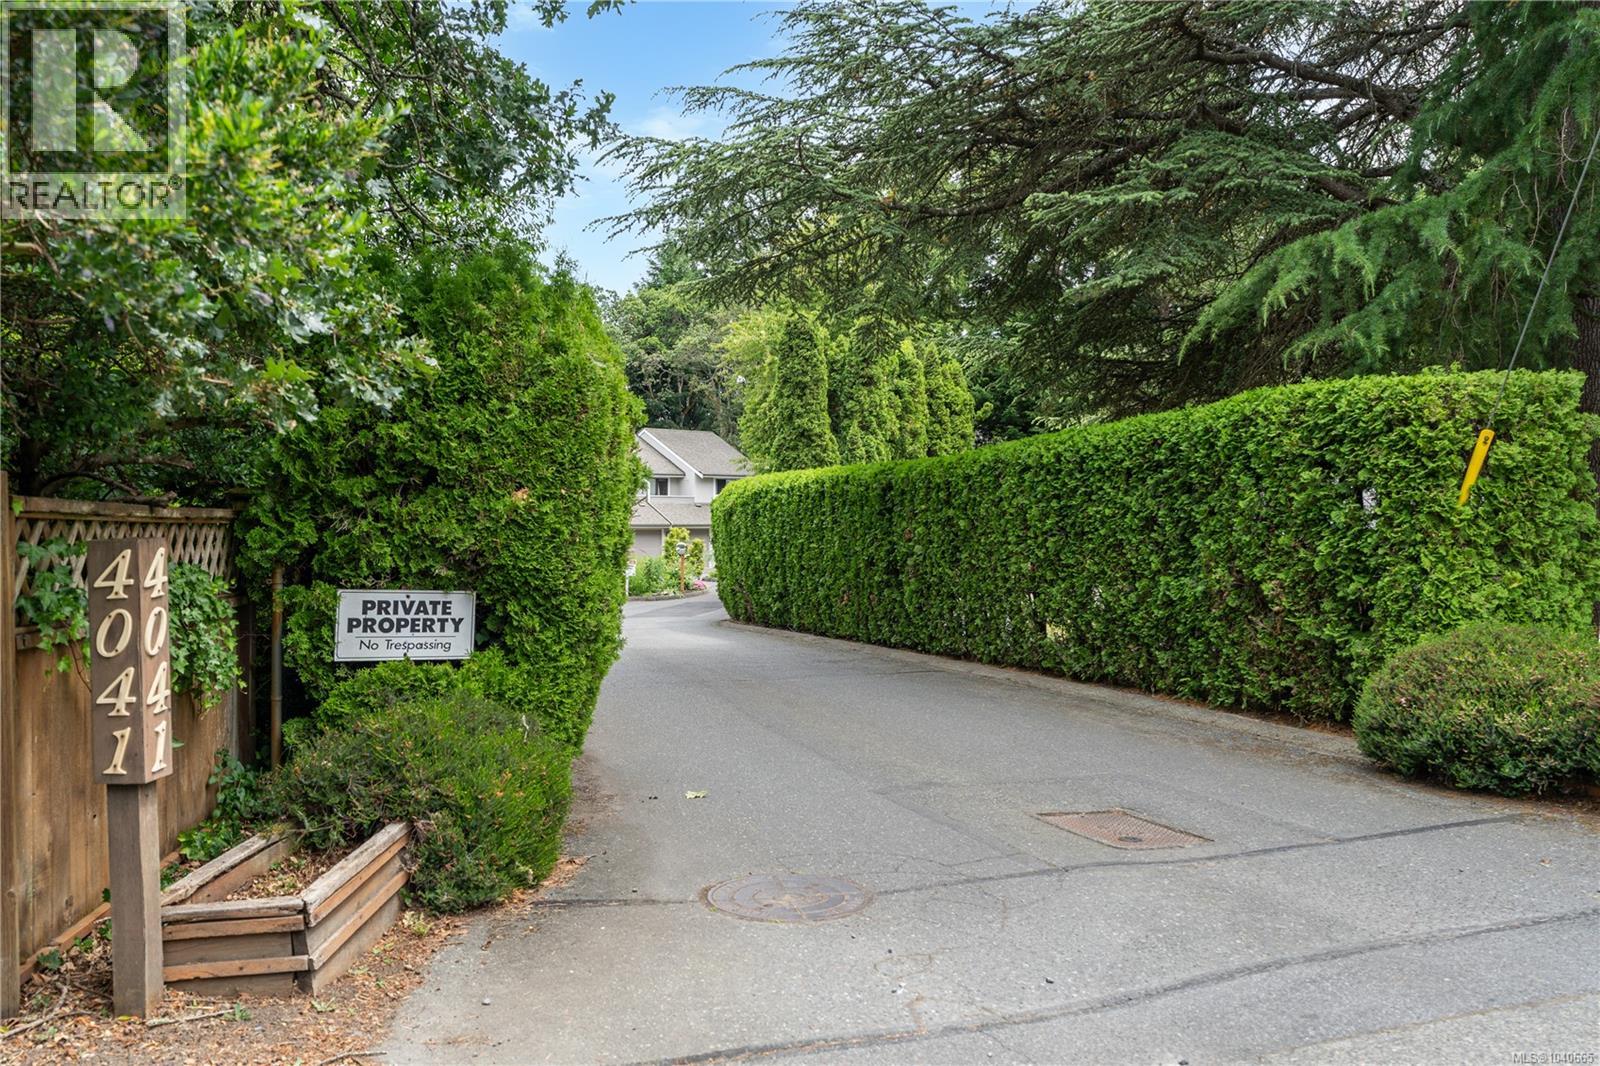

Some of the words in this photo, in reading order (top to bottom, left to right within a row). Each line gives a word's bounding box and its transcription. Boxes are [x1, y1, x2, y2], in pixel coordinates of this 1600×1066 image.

[361, 600, 453, 616] PRIVATE
[347, 617, 464, 634] PROPERTY
[359, 639, 379, 651] No
[385, 638, 452, 654] Trespassing
[93, 549, 136, 775] 4041
[143, 547, 171, 773] 4041
